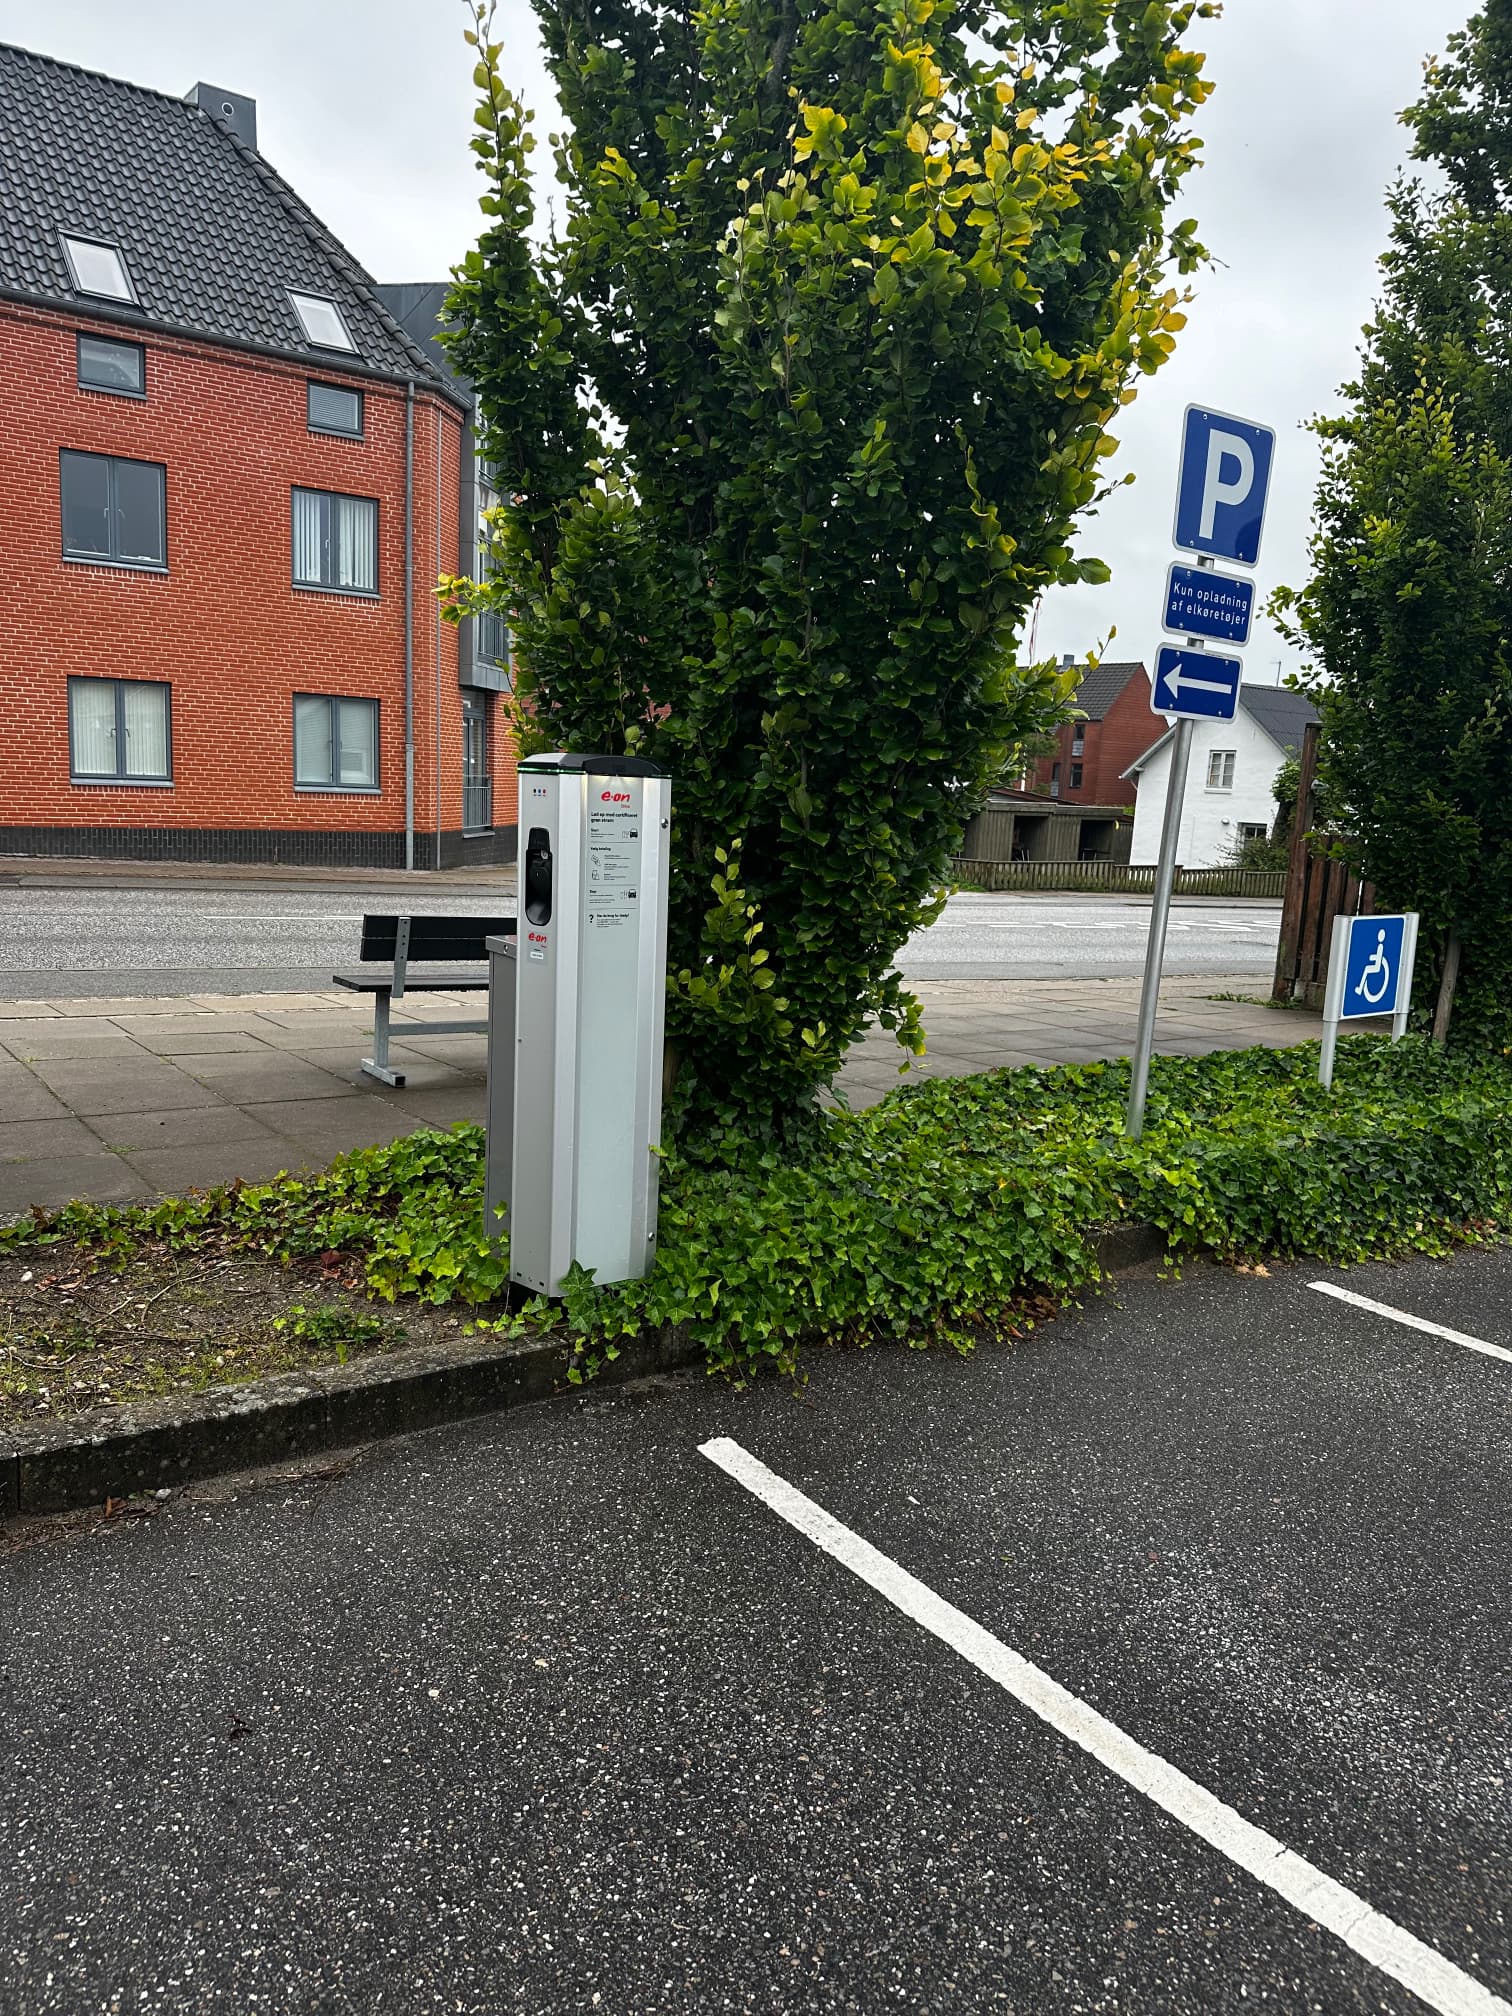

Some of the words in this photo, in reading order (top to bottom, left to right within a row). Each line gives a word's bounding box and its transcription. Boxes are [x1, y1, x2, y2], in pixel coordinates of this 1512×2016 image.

[1199, 428, 1254, 540] P
[1173, 581, 1193, 597] Kun
[1197, 590, 1247, 612] opladning
[1171, 600, 1184, 612] af
[1186, 602, 1246, 625] elkøretøjer
